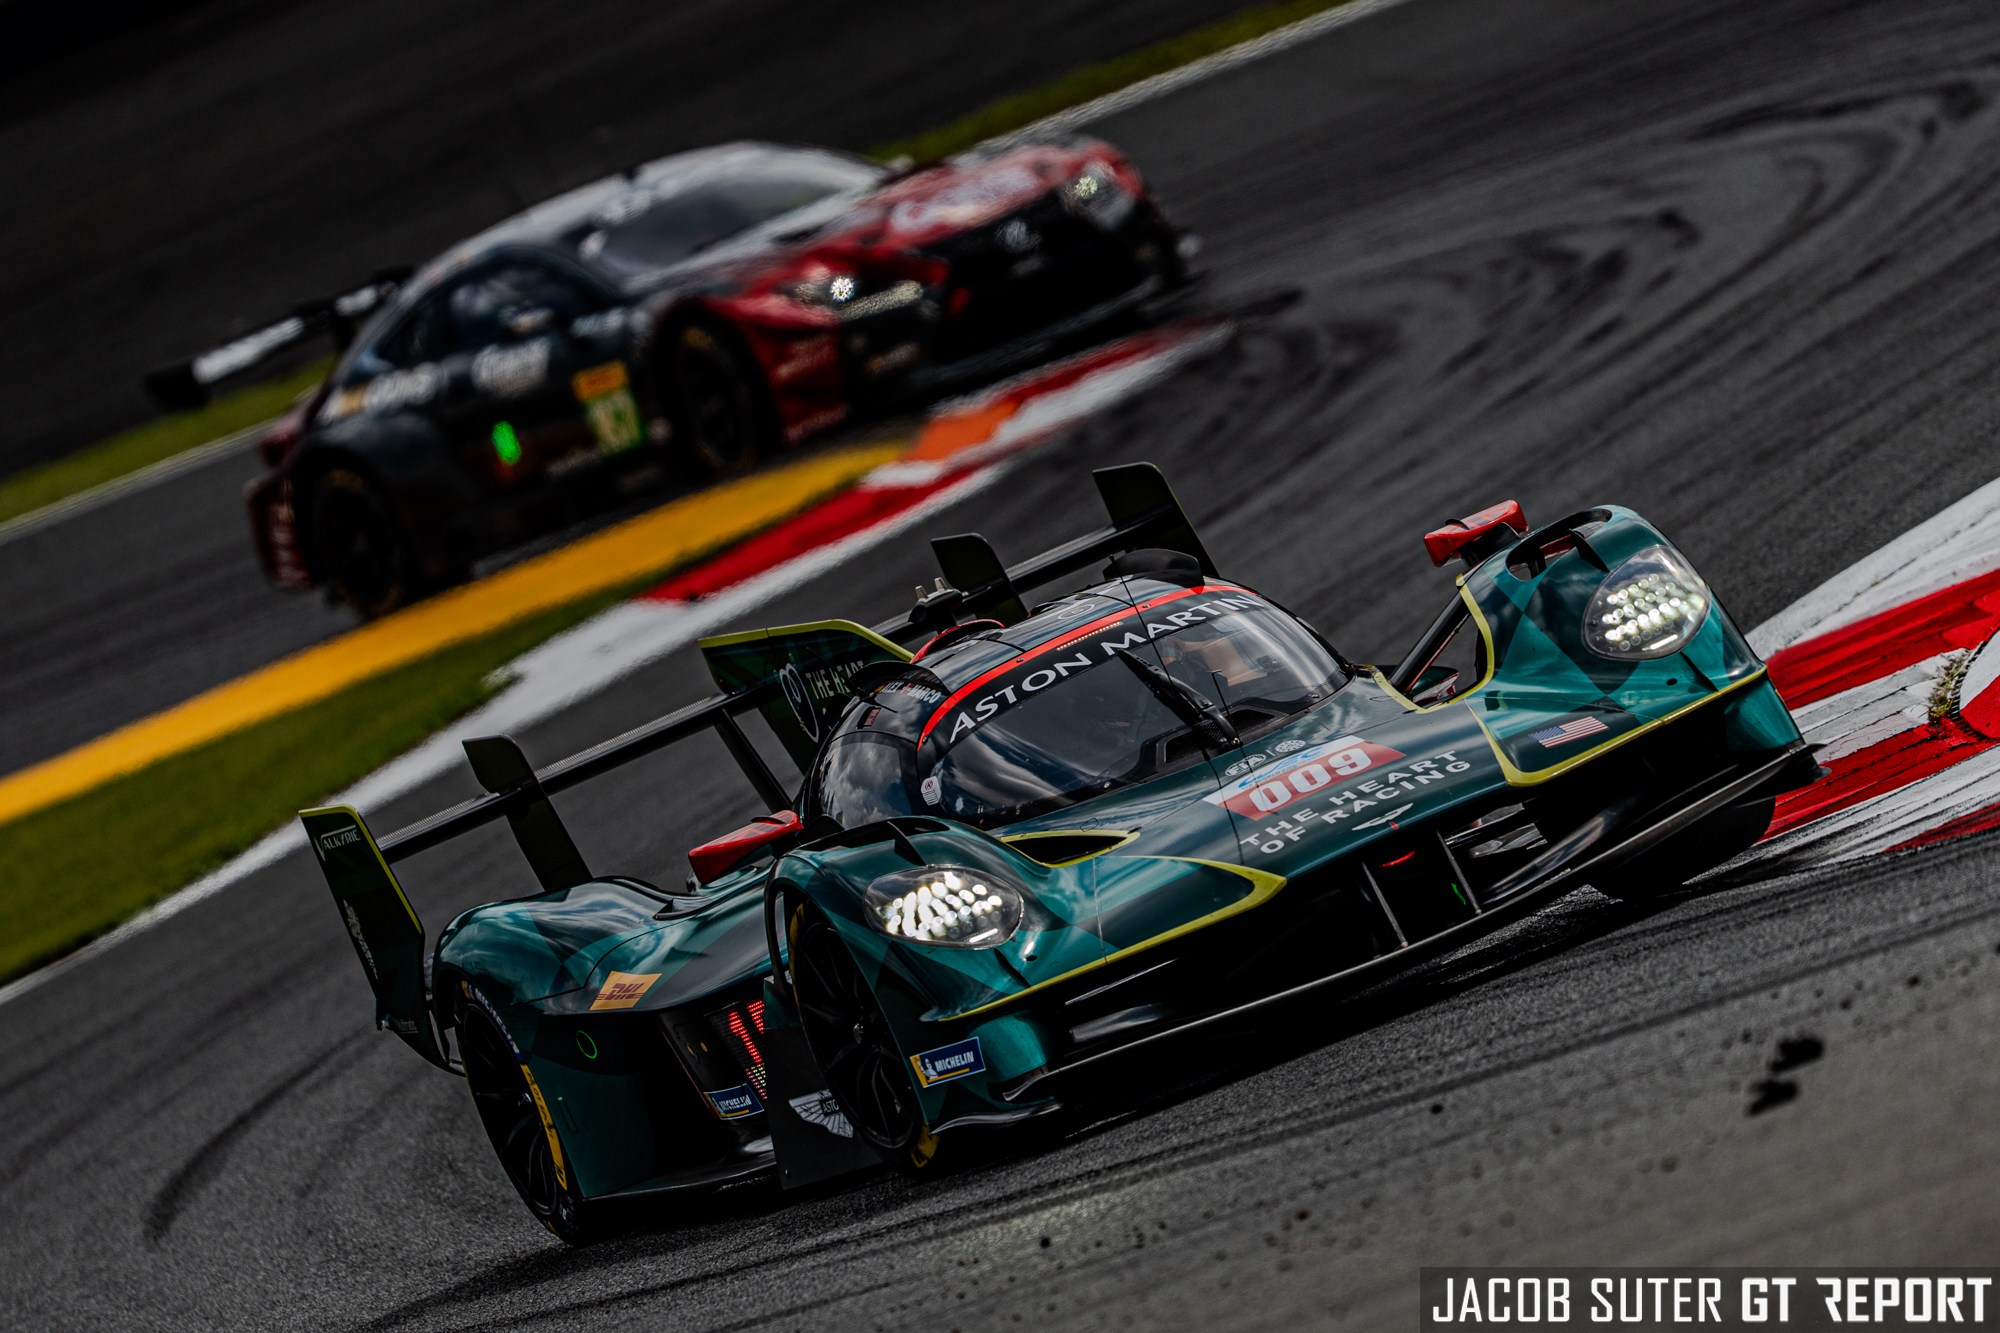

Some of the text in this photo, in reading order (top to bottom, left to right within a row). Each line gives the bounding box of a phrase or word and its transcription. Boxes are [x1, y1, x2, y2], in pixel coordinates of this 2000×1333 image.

[805, 669, 834, 700] THE
[950, 595, 1265, 743] ASTON MARTIN
[907, 682, 942, 704] MARCO
[1227, 755, 1265, 776] FIA
[1248, 748, 1372, 812] 009
[1239, 808, 1319, 847] THE
[1328, 750, 1456, 806] HEART
[1260, 827, 1306, 854] OF
[1321, 761, 1471, 824] RACING
[313, 824, 361, 862] VALKYRIE
[934, 1051, 975, 1073] MICHELIN
[822, 1099, 839, 1113] ASTO
